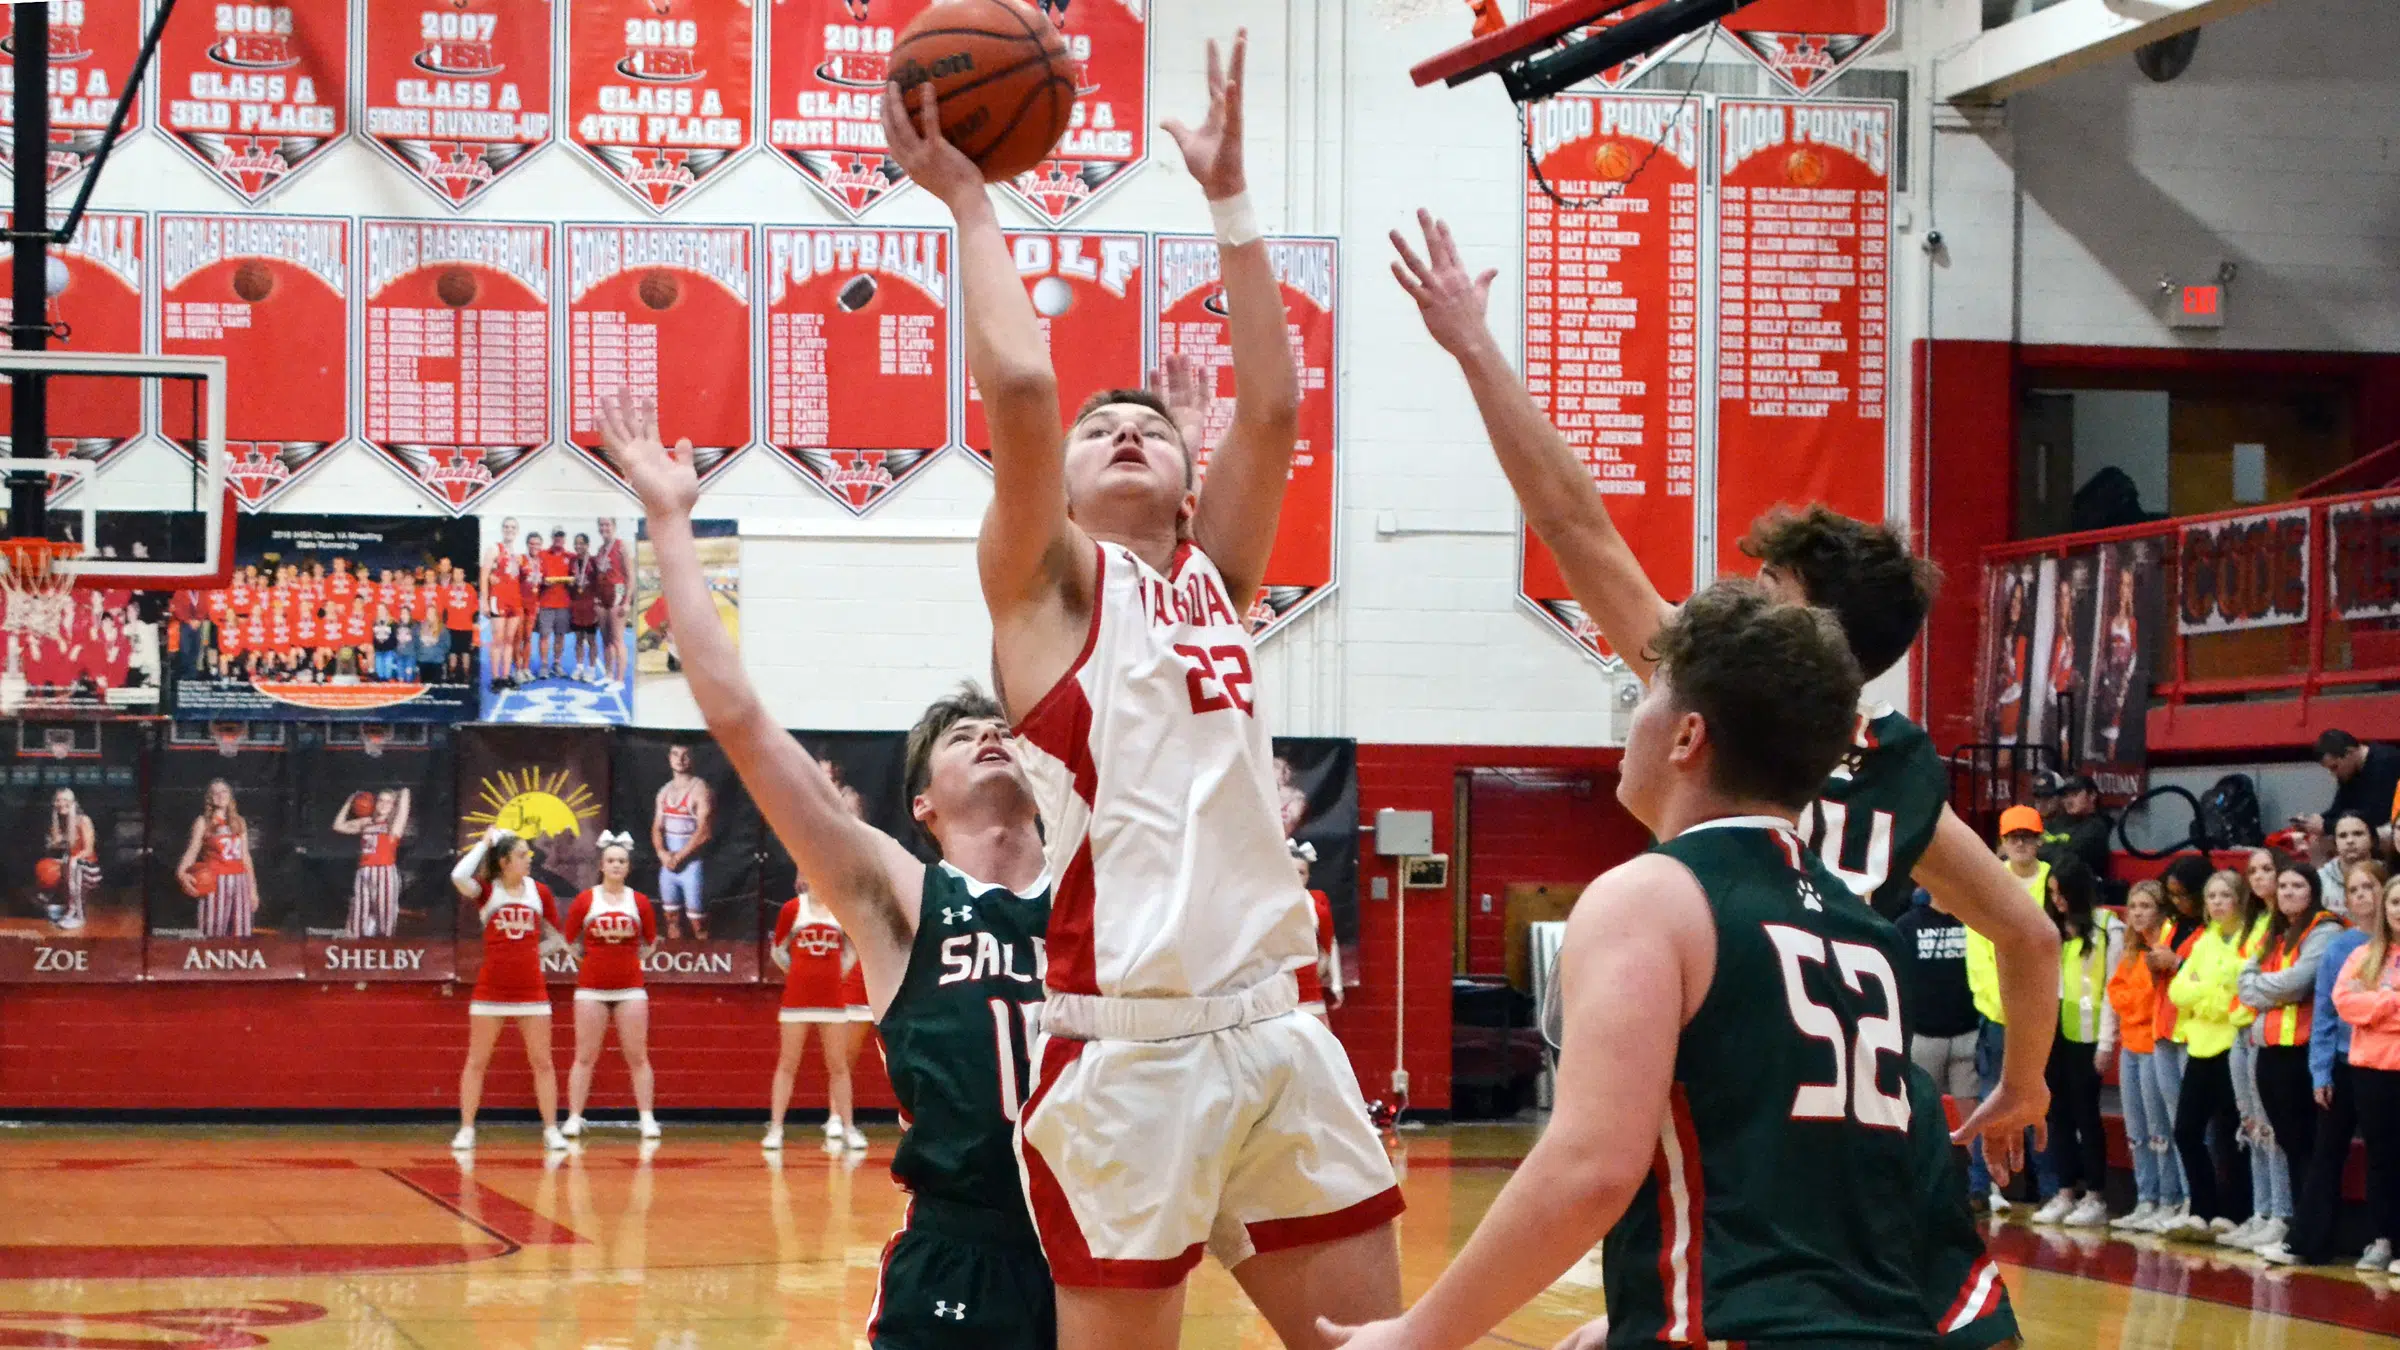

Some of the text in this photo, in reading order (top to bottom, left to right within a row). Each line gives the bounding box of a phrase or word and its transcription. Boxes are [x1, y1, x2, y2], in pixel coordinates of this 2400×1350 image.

[216, 5, 293, 33] 2002
[421, 11, 498, 41] 2007
[625, 18, 698, 47] 2016
[824, 24, 894, 53] 2018
[86, 69, 109, 96] A
[191, 73, 317, 103] CLASS A
[396, 79, 522, 110] CLASS A
[599, 86, 723, 116] CLASS A
[1093, 102, 1114, 128] A
[171, 101, 336, 133] 3RD PLACE
[368, 107, 550, 138] STATE RUNNER-UP
[579, 113, 742, 145] 4TH PLACE
[771, 118, 834, 145] STATE
[1053, 129, 1133, 157] LACE
[1530, 100, 1697, 170] 1000 POINTS
[1724, 105, 1886, 176] 1000 POINTS
[164, 219, 219, 291] GIRLS
[223, 221, 346, 298] BASKETBALL
[369, 226, 548, 302] BOYS BASKETBALL
[571, 229, 749, 307] BOYS BASKETBALL
[769, 231, 946, 309] FOOTBALL
[1015, 236, 1141, 298] OLF
[1173, 644, 1253, 718] 22
[33, 947, 89, 971] ZOE
[183, 946, 267, 970] ANNA
[324, 945, 425, 970] SHELBY
[639, 951, 732, 973] LOGAN
[1761, 922, 1911, 1134] 52
